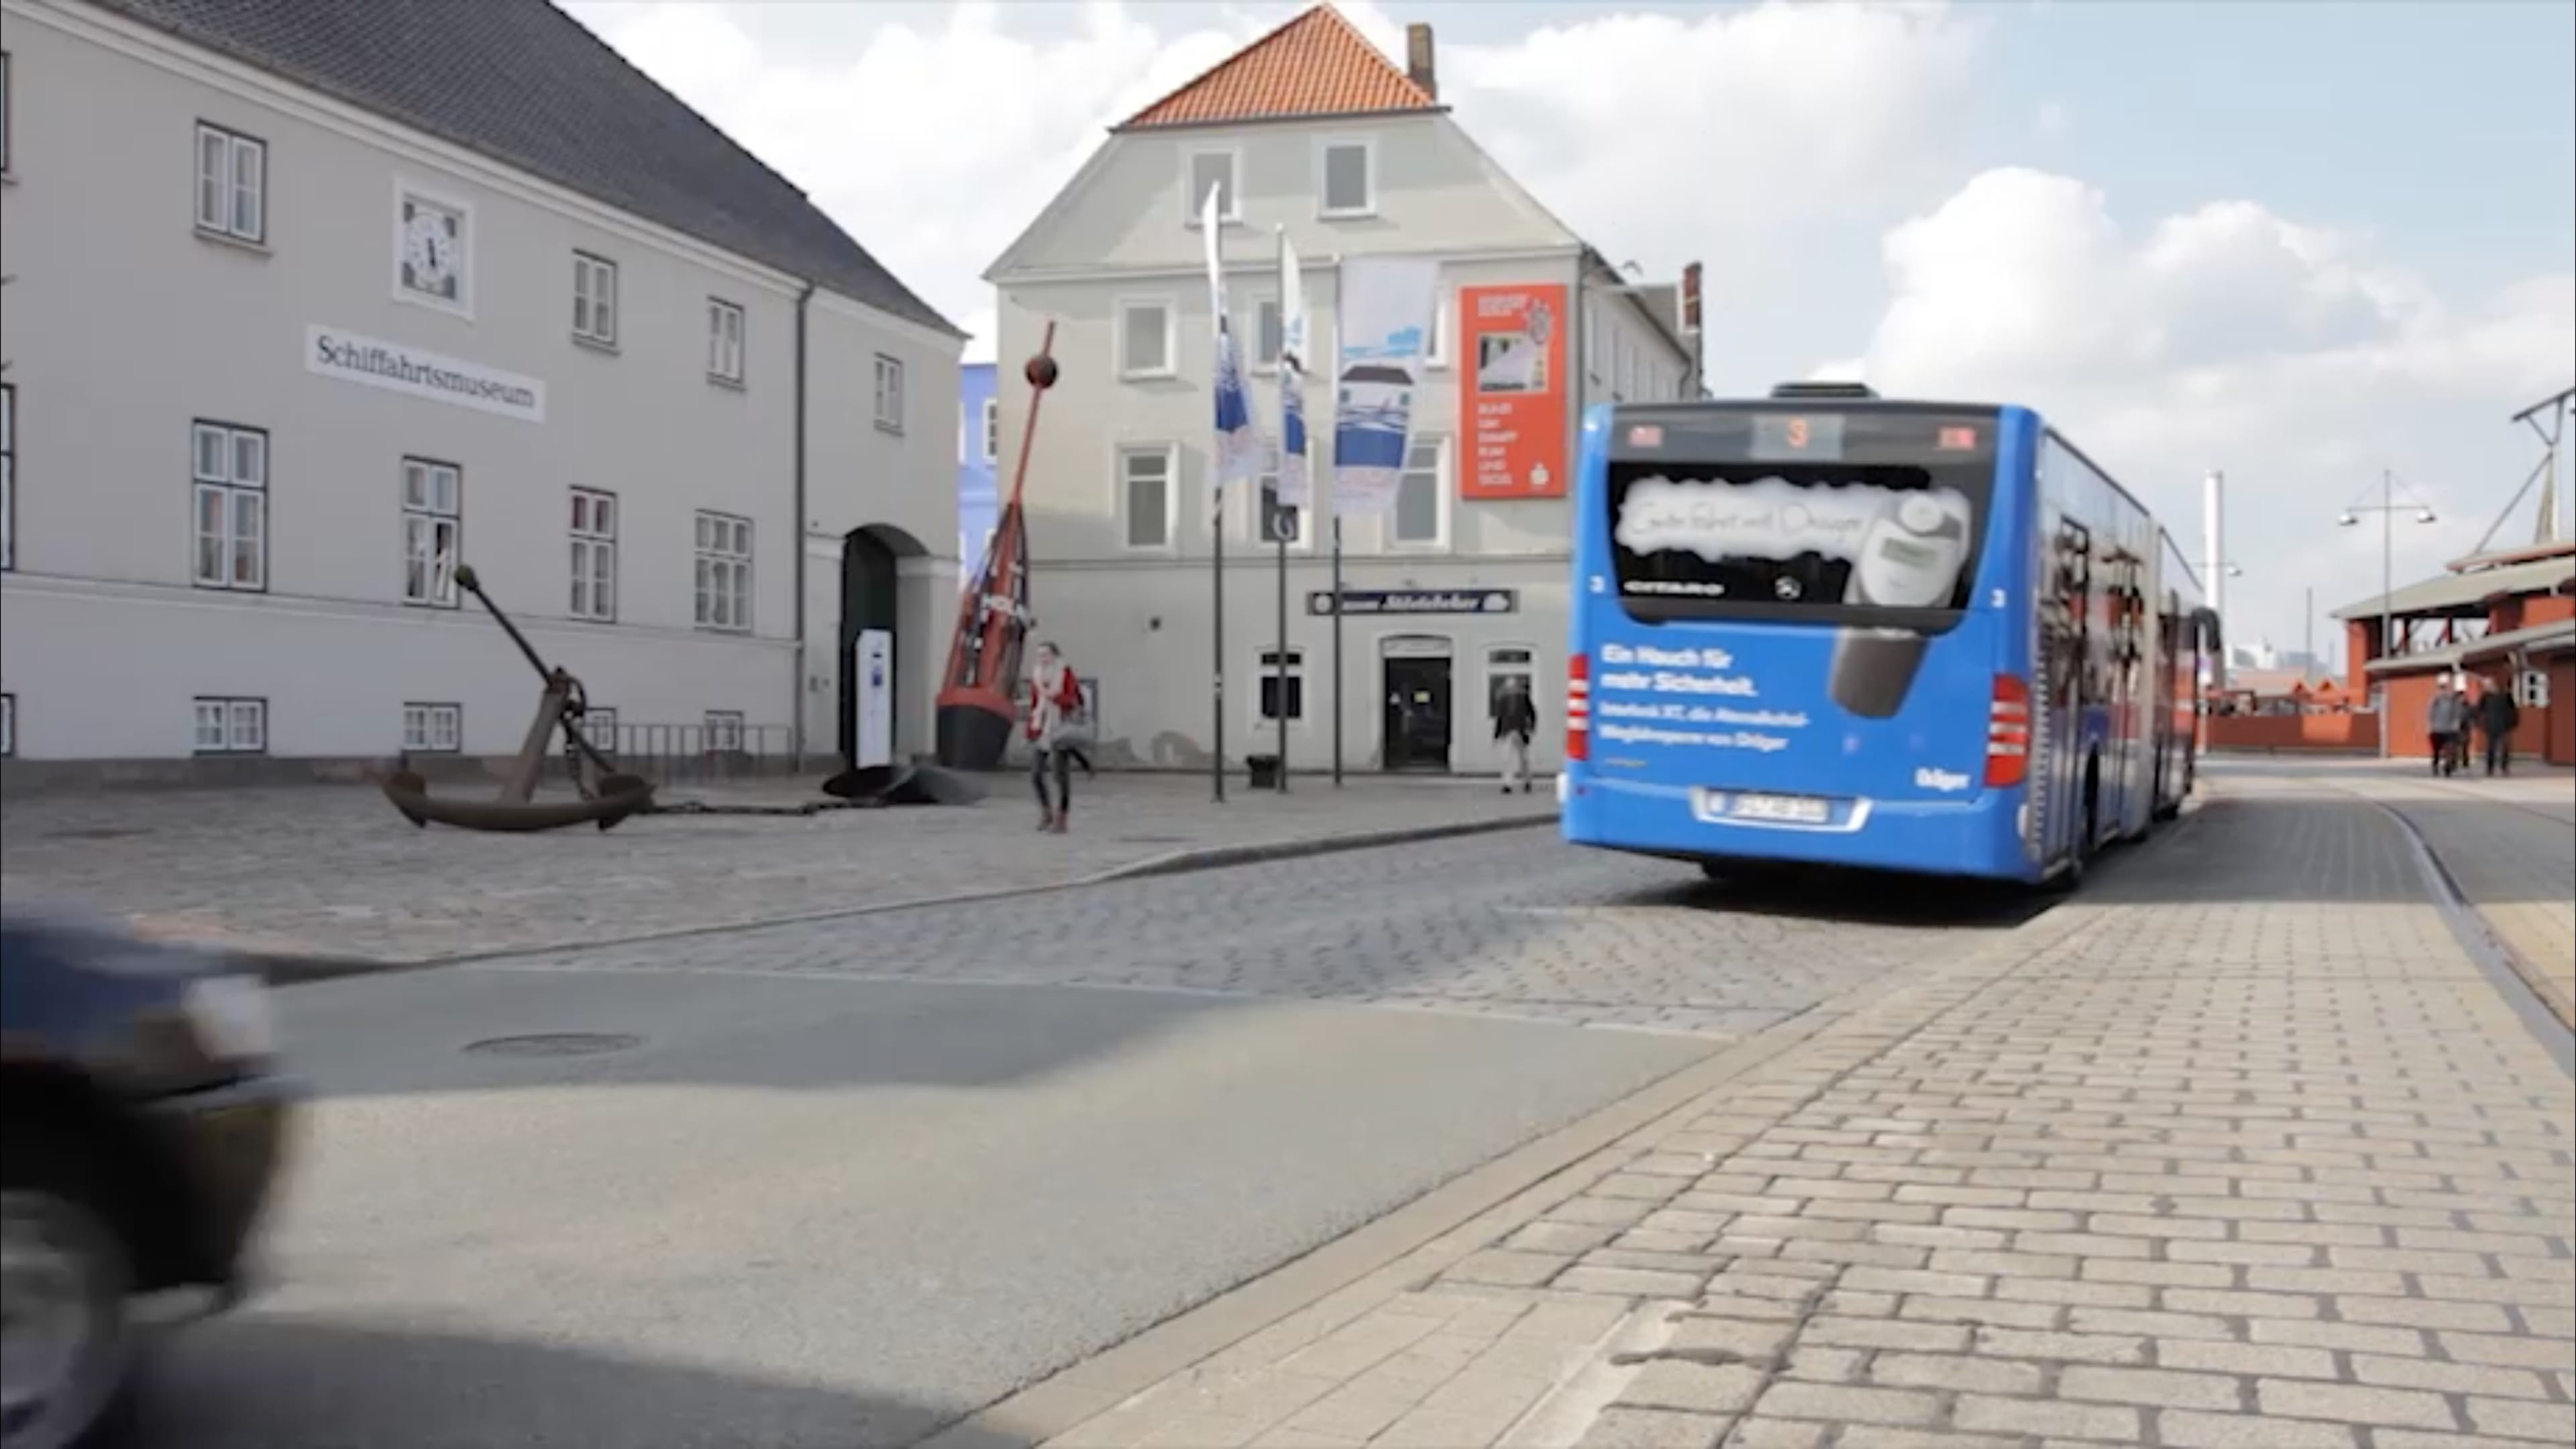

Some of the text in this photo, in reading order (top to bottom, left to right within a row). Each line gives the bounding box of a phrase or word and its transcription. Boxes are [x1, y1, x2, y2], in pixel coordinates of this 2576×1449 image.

[316, 334, 535, 408] Schiffahrtsmuseum
[1623, 579, 1725, 596] CITARO
[1601, 643, 1735, 669] Ein Hauch für
[1600, 672, 1650, 689] mehr
